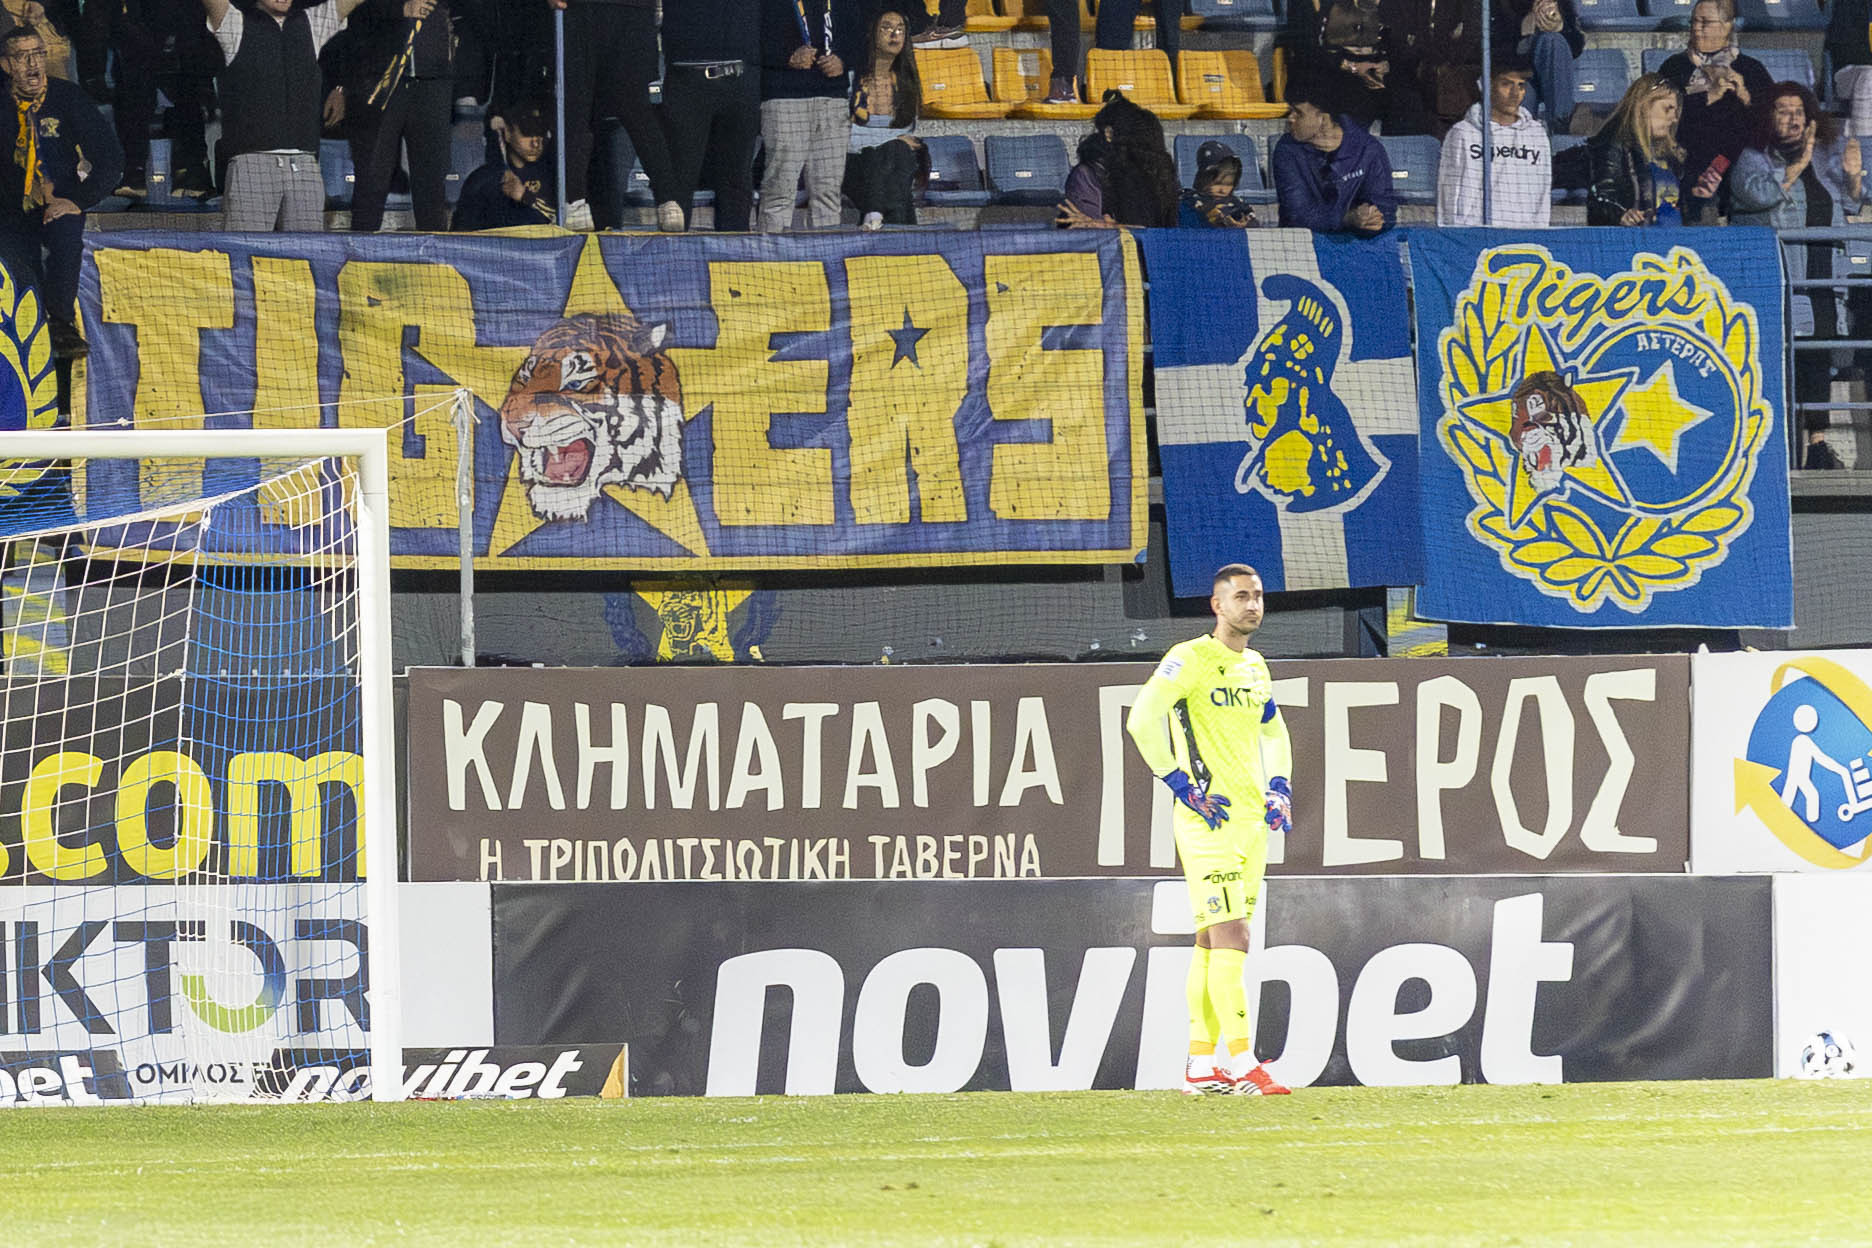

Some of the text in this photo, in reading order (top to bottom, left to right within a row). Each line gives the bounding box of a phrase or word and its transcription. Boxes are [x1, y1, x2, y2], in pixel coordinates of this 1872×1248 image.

[1470, 144, 1540, 165] Sperdry
[1486, 249, 1709, 333] Tigers
[443, 698, 1064, 812] ΚΛΗΜΑΤΑΡΙΑ
[480, 833, 1042, 881] Η ΤΡΙΠΟΛΙΤΣΙΩΤΙΚΗ ΤΑΒΕΡΝΑ
[135, 1062, 245, 1085] ΟΜΙΛΟΣ
